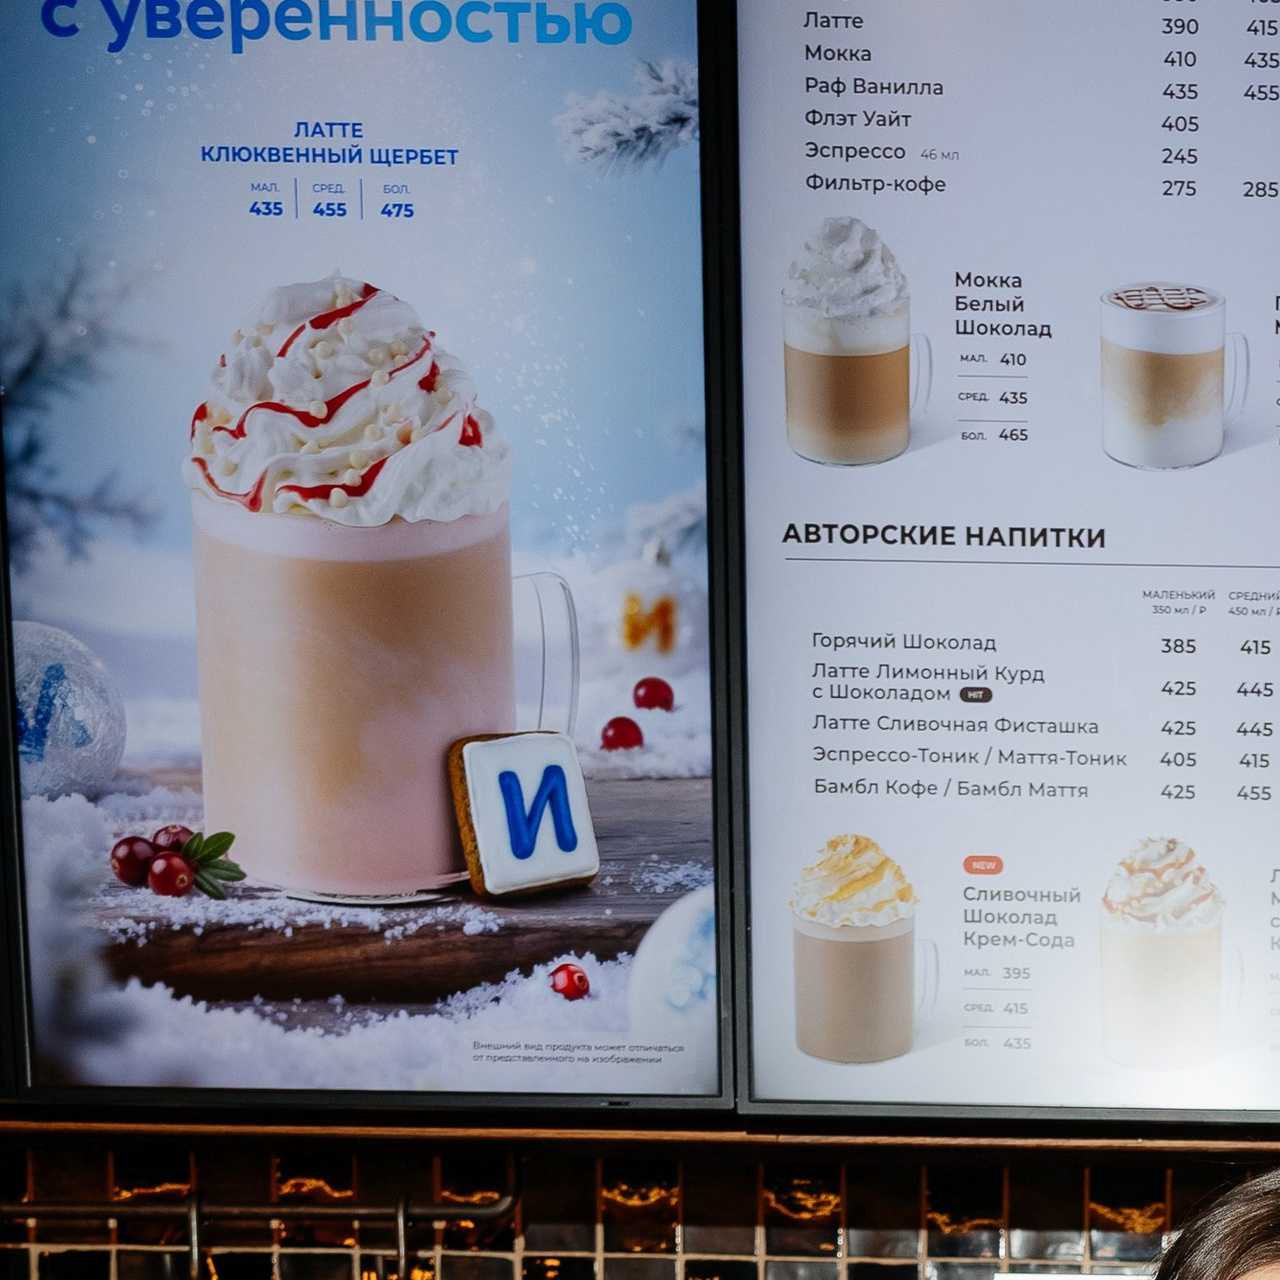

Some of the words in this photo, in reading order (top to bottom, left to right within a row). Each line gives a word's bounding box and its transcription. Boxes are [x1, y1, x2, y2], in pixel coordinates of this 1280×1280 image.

[41, 0, 79, 38] с
[101, 0, 632, 54] уверенностью
[804, 12, 863, 28] Латте
[1162, 19, 1198, 34] 390
[1247, 20, 1278, 36] 415
[806, 45, 871, 61] Мокка
[1164, 51, 1196, 67] 410
[1244, 53, 1279, 68] 435
[806, 77, 846, 97] Раф
[854, 78, 943, 95] Ванилла
[1163, 84, 1198, 99] 435
[1244, 85, 1279, 101] 455
[295, 122, 363, 138] ЛАТТЕ
[805, 109, 857, 125] Флэт
[863, 111, 911, 127] Уайт
[1162, 116, 1199, 132] 405
[202, 144, 362, 163] КЛЮКВЕННЫЙ
[370, 149, 459, 167] ЩЕРБЕТ
[806, 142, 905, 162] Эспрессо
[920, 149, 937, 160] 46
[941, 152, 959, 160] мл
[1162, 148, 1197, 164] 245
[251, 183, 277, 192] МАЛ.
[313, 184, 345, 194] СРЕД.
[384, 185, 410, 194] БОЛ.
[806, 174, 946, 195] Фильтр-кофе
[1163, 180, 1196, 196] 275
[1244, 182, 1278, 197] 285
[250, 202, 283, 216] 435
[313, 203, 346, 216] 455
[381, 204, 414, 217] 475
[956, 272, 1021, 288] Мокка
[956, 296, 1023, 311] Белый
[956, 320, 1052, 338] Шоколад
[782, 524, 955, 545] АВТОРСКИЕ
[967, 527, 1104, 548] НАПИТКИ
[1143, 590, 1215, 599] МАЛЕНЬКИЙ
[813, 633, 895, 651] Горячий
[904, 634, 996, 652] Шоколад
[812, 663, 869, 678] Латте
[876, 664, 987, 680] Лимонный
[996, 666, 1044, 684] Курд
[813, 687, 822, 698] с
[830, 684, 950, 702] Шоколадом
[813, 715, 870, 730] Латте
[877, 716, 987, 731] Сливочная
[995, 718, 1098, 733] Фисташка
[814, 746, 978, 765] Эспрессо-Тоник
[999, 750, 1126, 765] Маття-Тоник
[815, 779, 878, 794] Бамбл
[887, 780, 937, 798] Кофе
[958, 781, 1021, 796] Бамбл
[1029, 783, 1088, 797] Маття
[498, 764, 577, 860] И
[963, 887, 1080, 902] Сливочный
[964, 909, 1057, 926] Шоколад
[1270, 917, 1280, 928] с
[964, 931, 1074, 949] Крем-Сода
